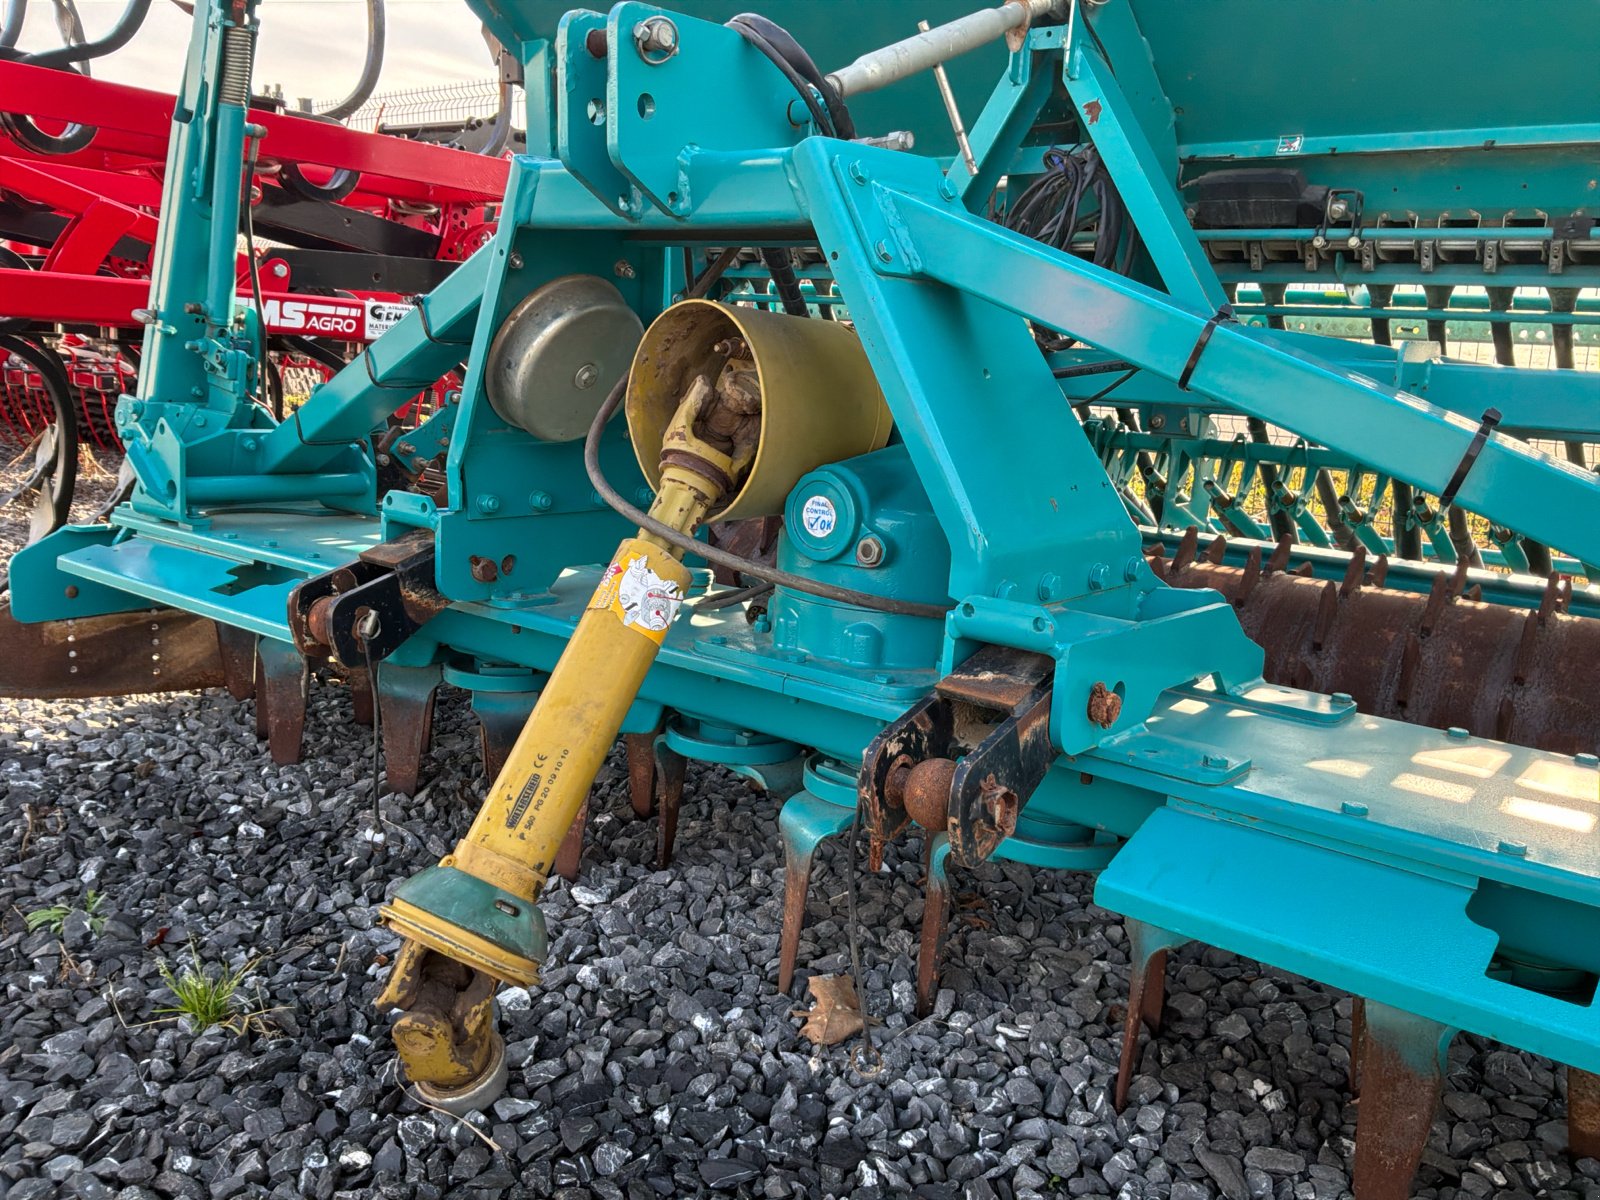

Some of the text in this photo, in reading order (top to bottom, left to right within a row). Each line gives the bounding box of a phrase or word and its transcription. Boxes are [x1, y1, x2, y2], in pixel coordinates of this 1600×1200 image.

[236, 297, 357, 333] MS AGRO
[805, 507, 833, 517] CONTROL
[812, 500, 828, 508] FINAL
[820, 519, 832, 531] OK
[534, 799, 544, 812] PG
[540, 786, 550, 799] 20
[547, 773, 557, 786] 09
[554, 761, 563, 772] 10
[561, 748, 569, 760] 10
[506, 772, 541, 829] WALTERSCHEID
